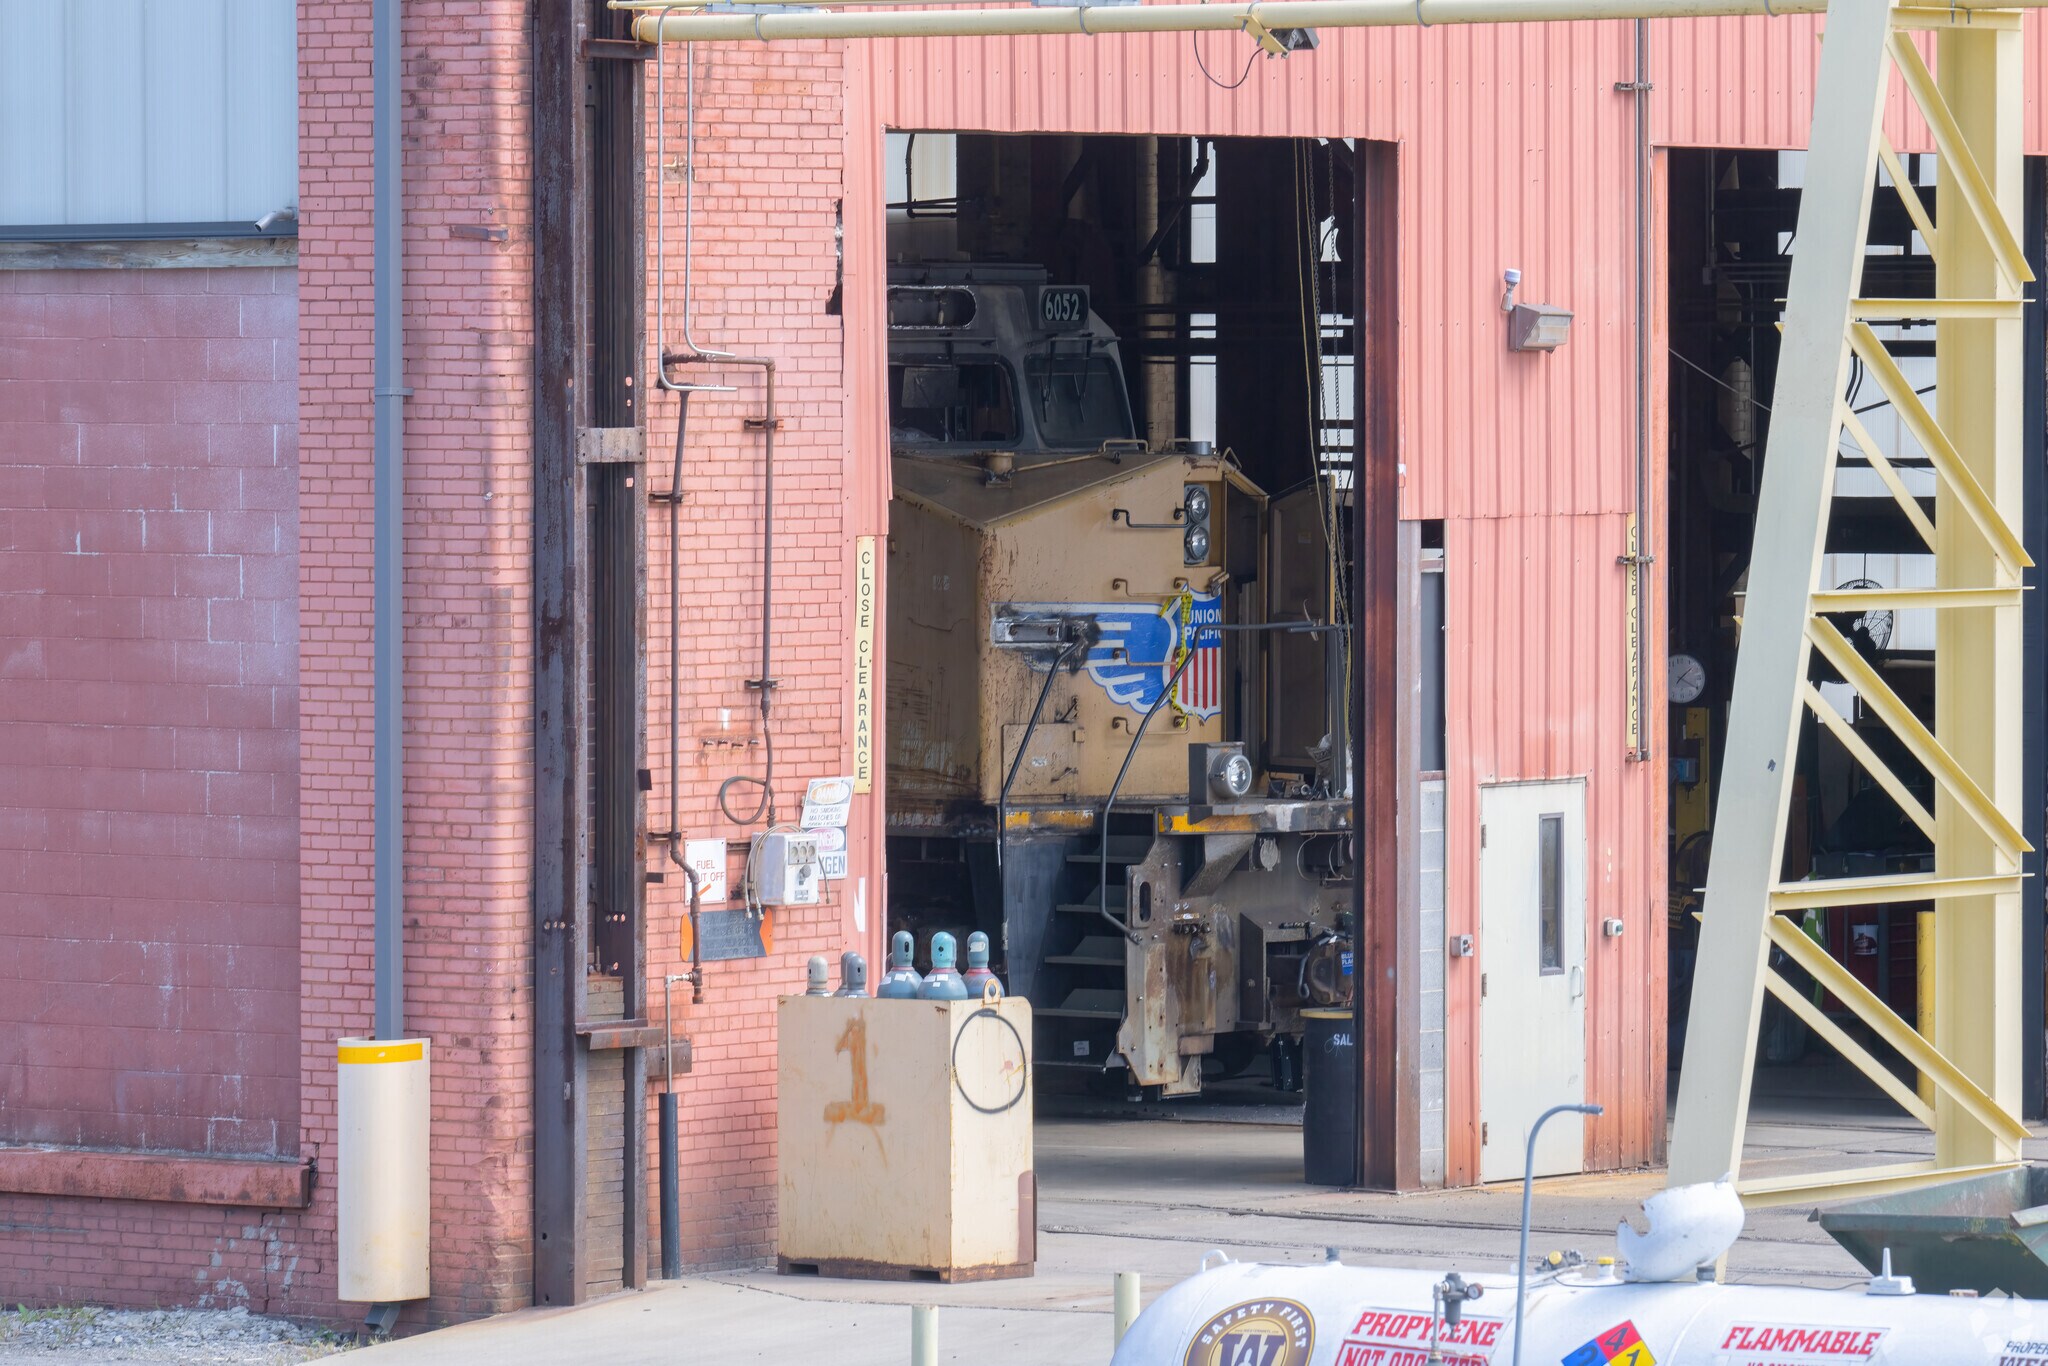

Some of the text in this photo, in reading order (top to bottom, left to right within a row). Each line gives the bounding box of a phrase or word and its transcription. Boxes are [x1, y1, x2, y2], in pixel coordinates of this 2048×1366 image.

[1046, 293, 1080, 320] 6052
[1190, 608, 1222, 624] UNION
[858, 551, 871, 780] CLOSE CLEARANCE
[696, 859, 715, 870] FUEL
[710, 871, 725, 882] OFF
[1333, 1033, 1354, 1046] SAL
[823, 1012, 886, 1126] 1
[1201, 1303, 1307, 1348] SAFETY FIRST
[1351, 1311, 1504, 1347] PROPYLENE
[1604, 1327, 1629, 1352] 4
[1720, 1326, 1882, 1355] FLAMMABLE
[1577, 1345, 1641, 1366] 2 1
